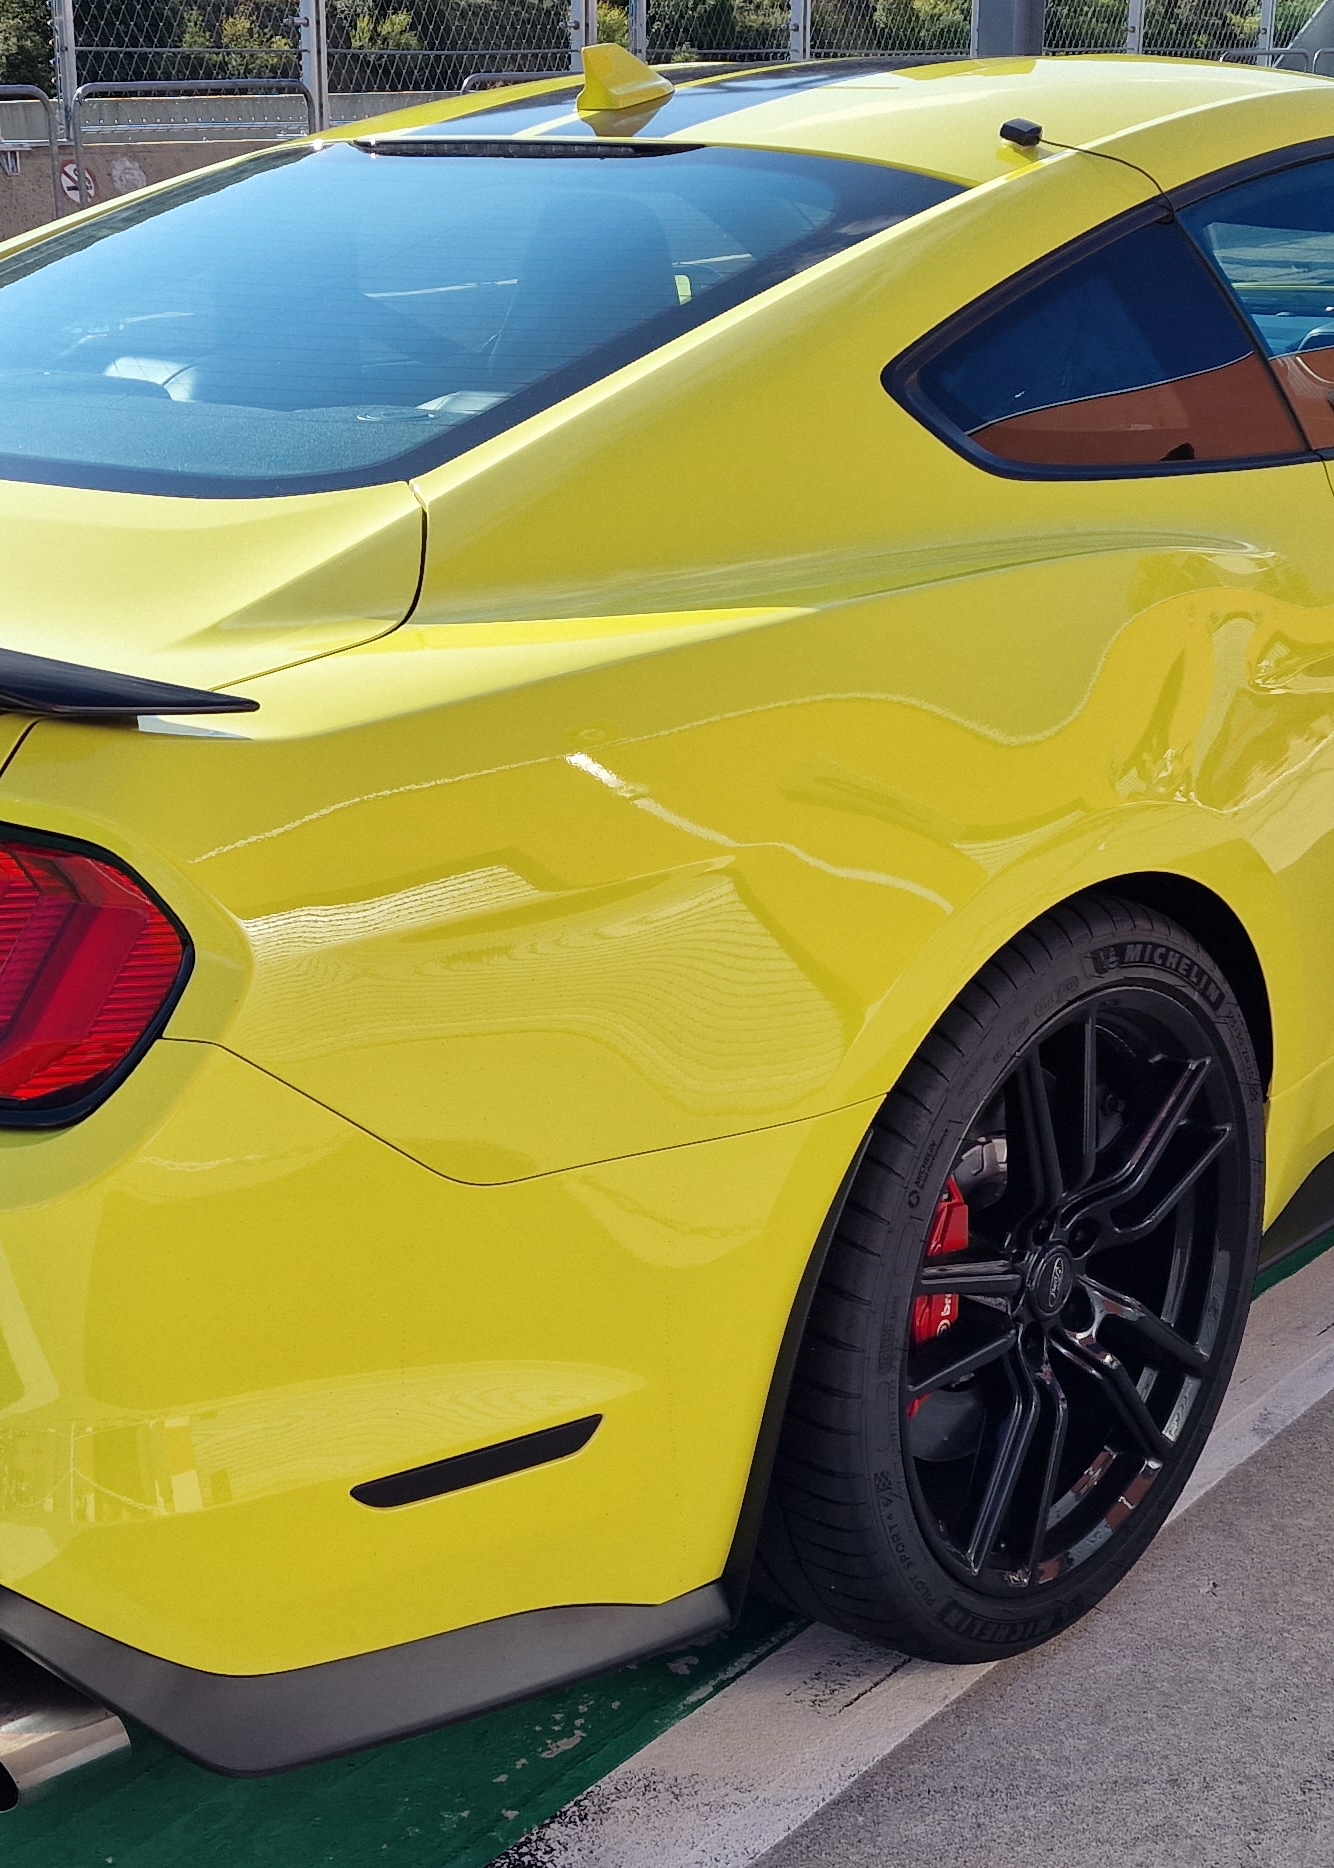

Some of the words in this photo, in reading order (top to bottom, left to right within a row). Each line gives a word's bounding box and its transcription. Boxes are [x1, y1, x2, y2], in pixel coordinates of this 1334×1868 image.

[1124, 944, 1222, 1004] MICHELIN
[889, 1524, 913, 1572] SPORT
[909, 1576, 935, 1607] PILOT
